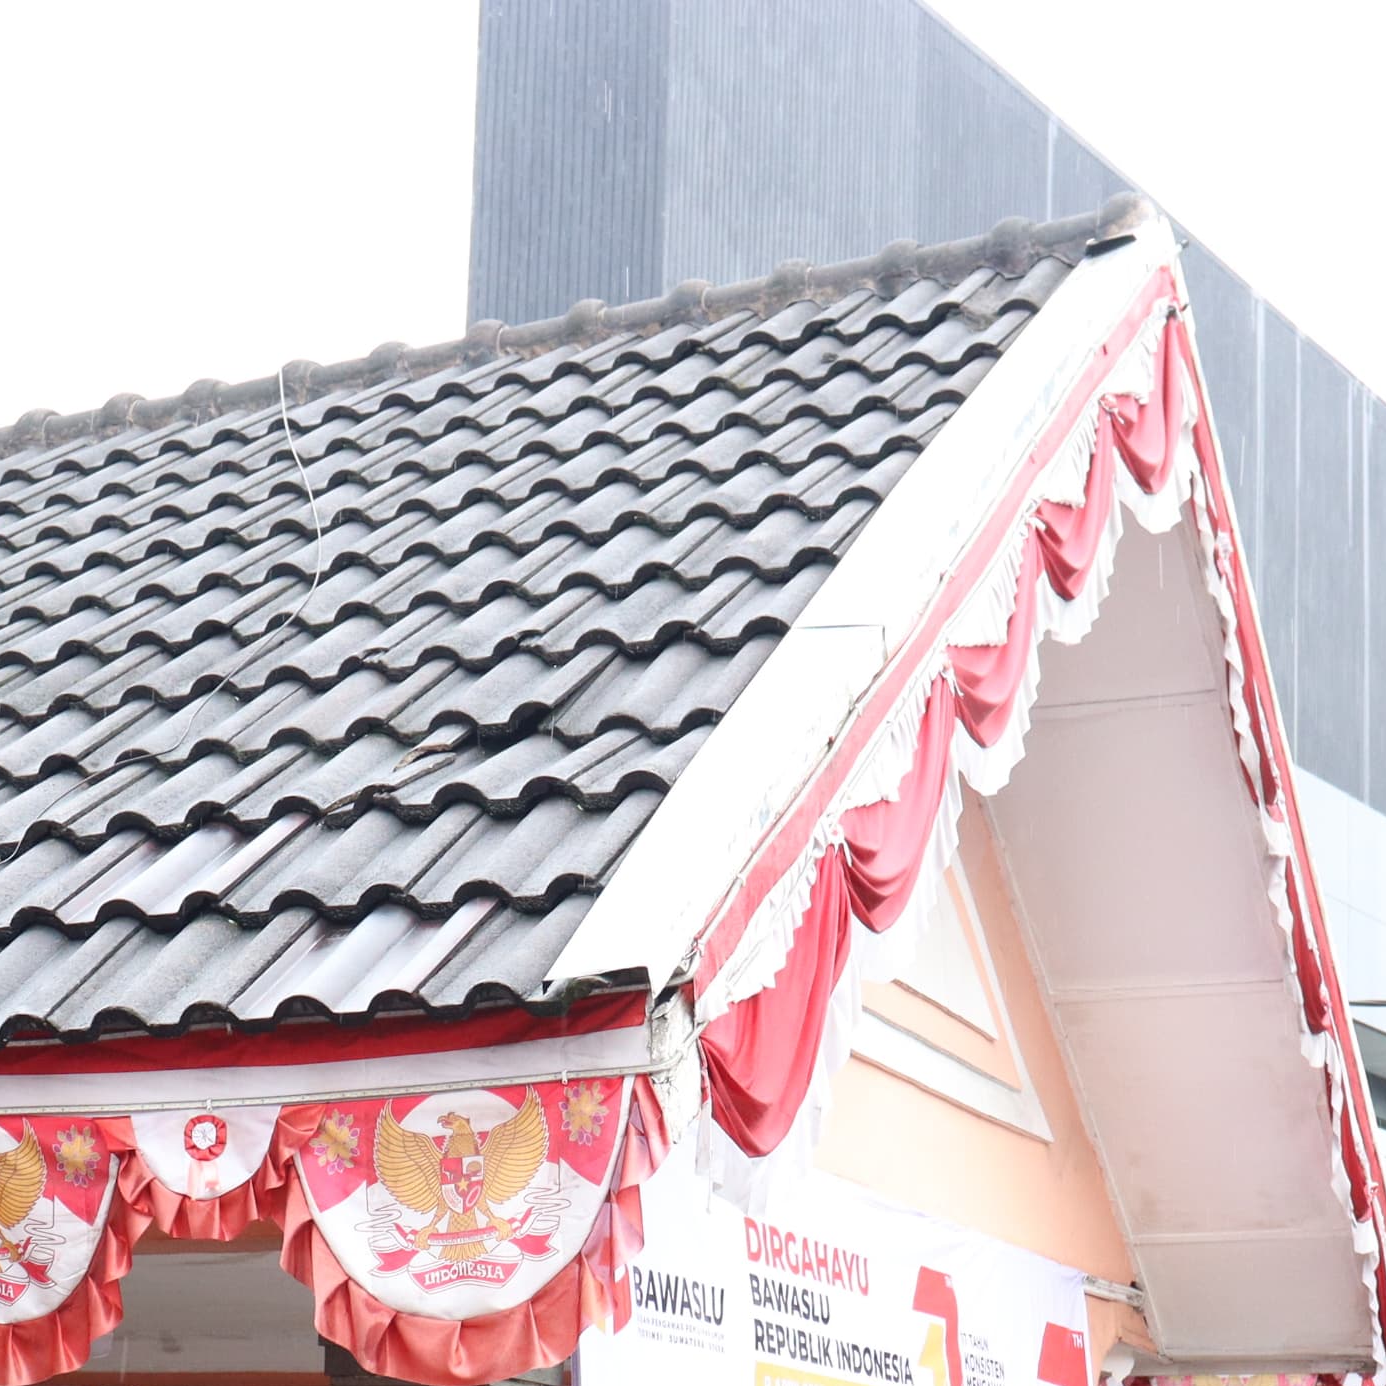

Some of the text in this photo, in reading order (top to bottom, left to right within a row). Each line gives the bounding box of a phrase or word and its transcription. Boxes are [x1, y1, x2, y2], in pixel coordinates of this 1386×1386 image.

[424, 1261, 505, 1285] INDONESIA
[744, 1217, 869, 1296] DIRGAHAYU
[633, 1265, 725, 1326] BAWASLU
[749, 1272, 830, 1325] BAWASLU
[753, 1318, 914, 1386] REPUBLIK INDONESIA
[964, 1352, 1005, 1380] KONSISTEN
[1071, 1333, 1084, 1349] TH
